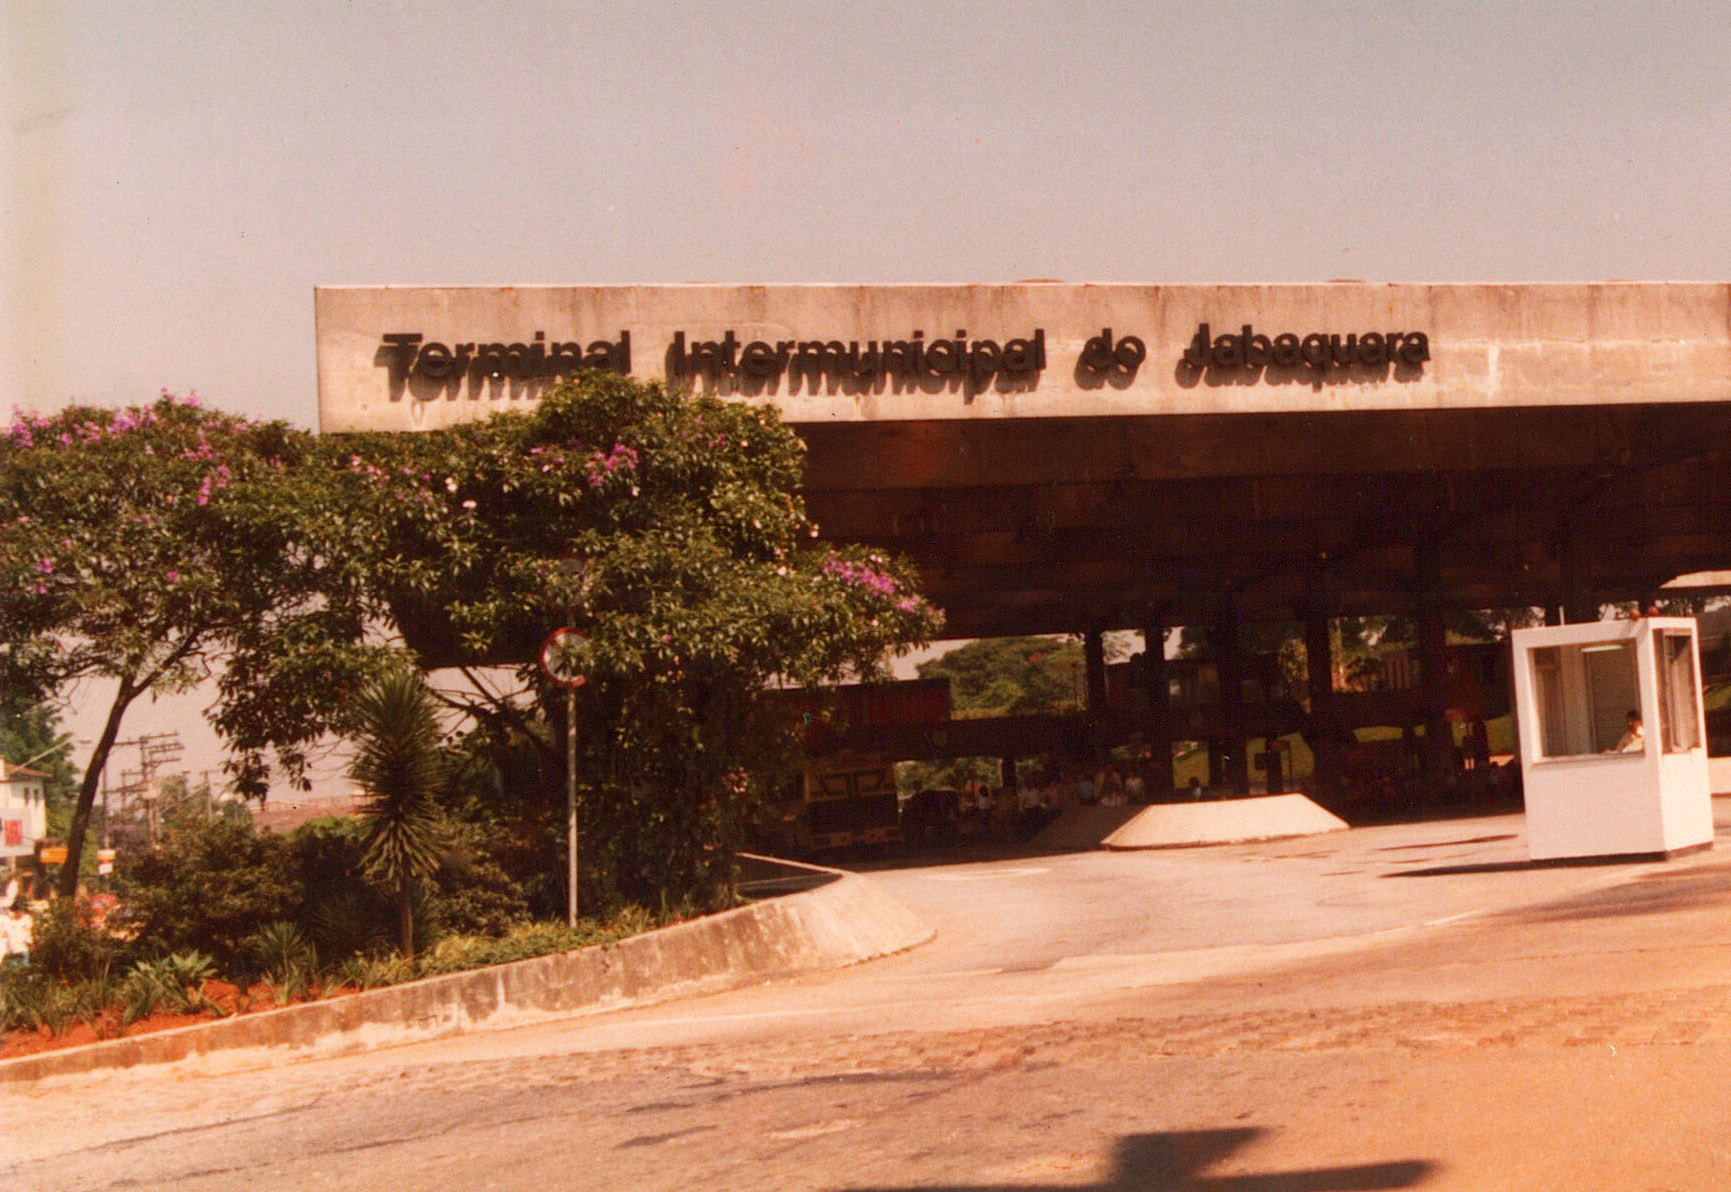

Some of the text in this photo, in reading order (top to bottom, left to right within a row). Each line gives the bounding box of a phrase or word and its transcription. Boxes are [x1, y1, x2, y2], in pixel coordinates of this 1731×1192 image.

[382, 323, 1430, 388] Terminal Intermunicipal do Jabaquara
